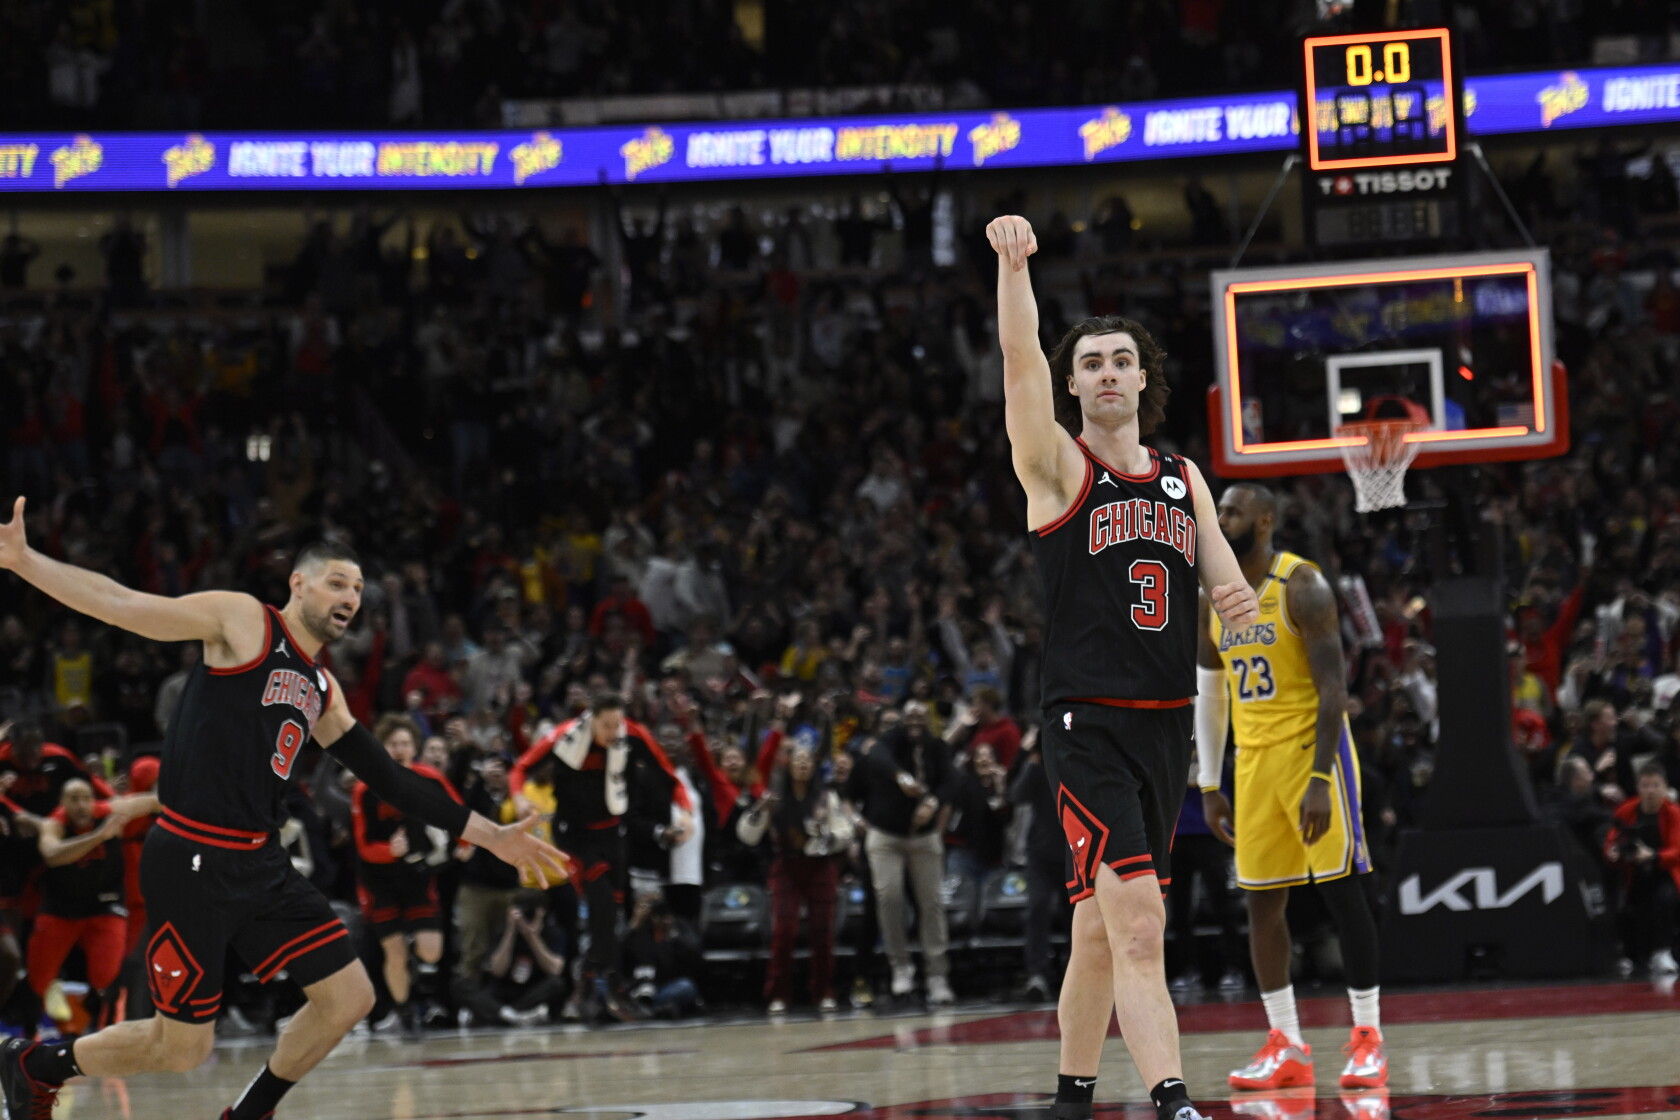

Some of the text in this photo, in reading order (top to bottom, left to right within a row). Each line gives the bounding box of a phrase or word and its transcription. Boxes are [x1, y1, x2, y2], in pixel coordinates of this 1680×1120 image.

[1346, 42, 1411, 86] 0.0
[686, 123, 958, 168] IGNITE YOUR INTENSITY
[1144, 107, 1224, 146] IGNITE
[1224, 102, 1290, 140] YOUR
[228, 141, 499, 177] IGNITE YOUR INTENSITY
[1354, 167, 1452, 195] TISSOT
[1089, 498, 1196, 567] CHICAGO
[1129, 559, 1169, 631] 3
[1231, 655, 1277, 703] 23
[270, 718, 305, 781] 9
